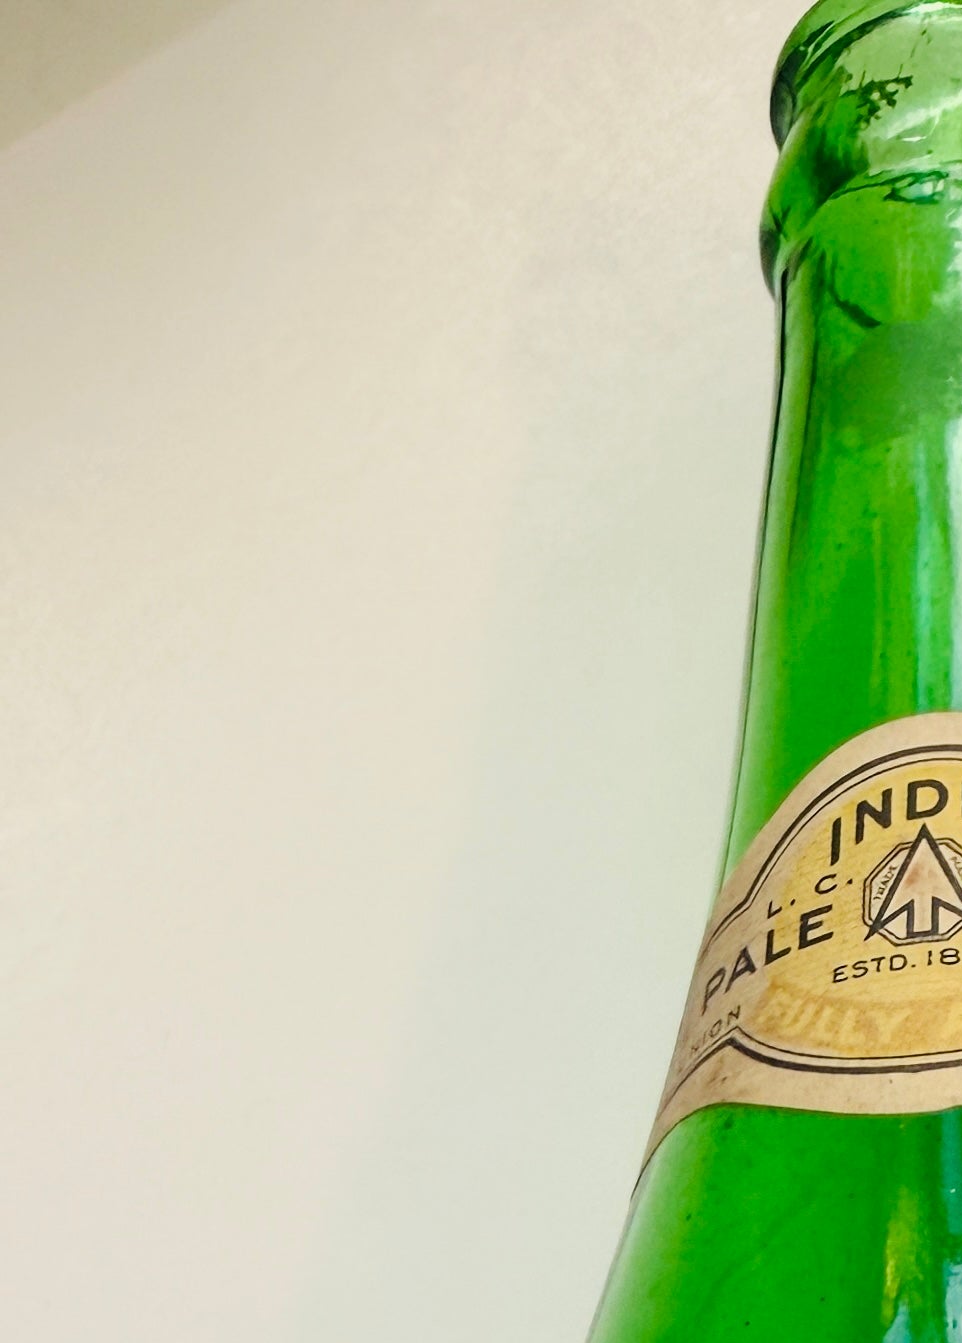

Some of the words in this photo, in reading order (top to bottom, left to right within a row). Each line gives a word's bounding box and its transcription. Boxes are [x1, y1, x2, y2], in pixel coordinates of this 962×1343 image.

[814, 873, 854, 895] C.
[702, 903, 834, 1017] PALE
[832, 953, 917, 984] ESTD.
